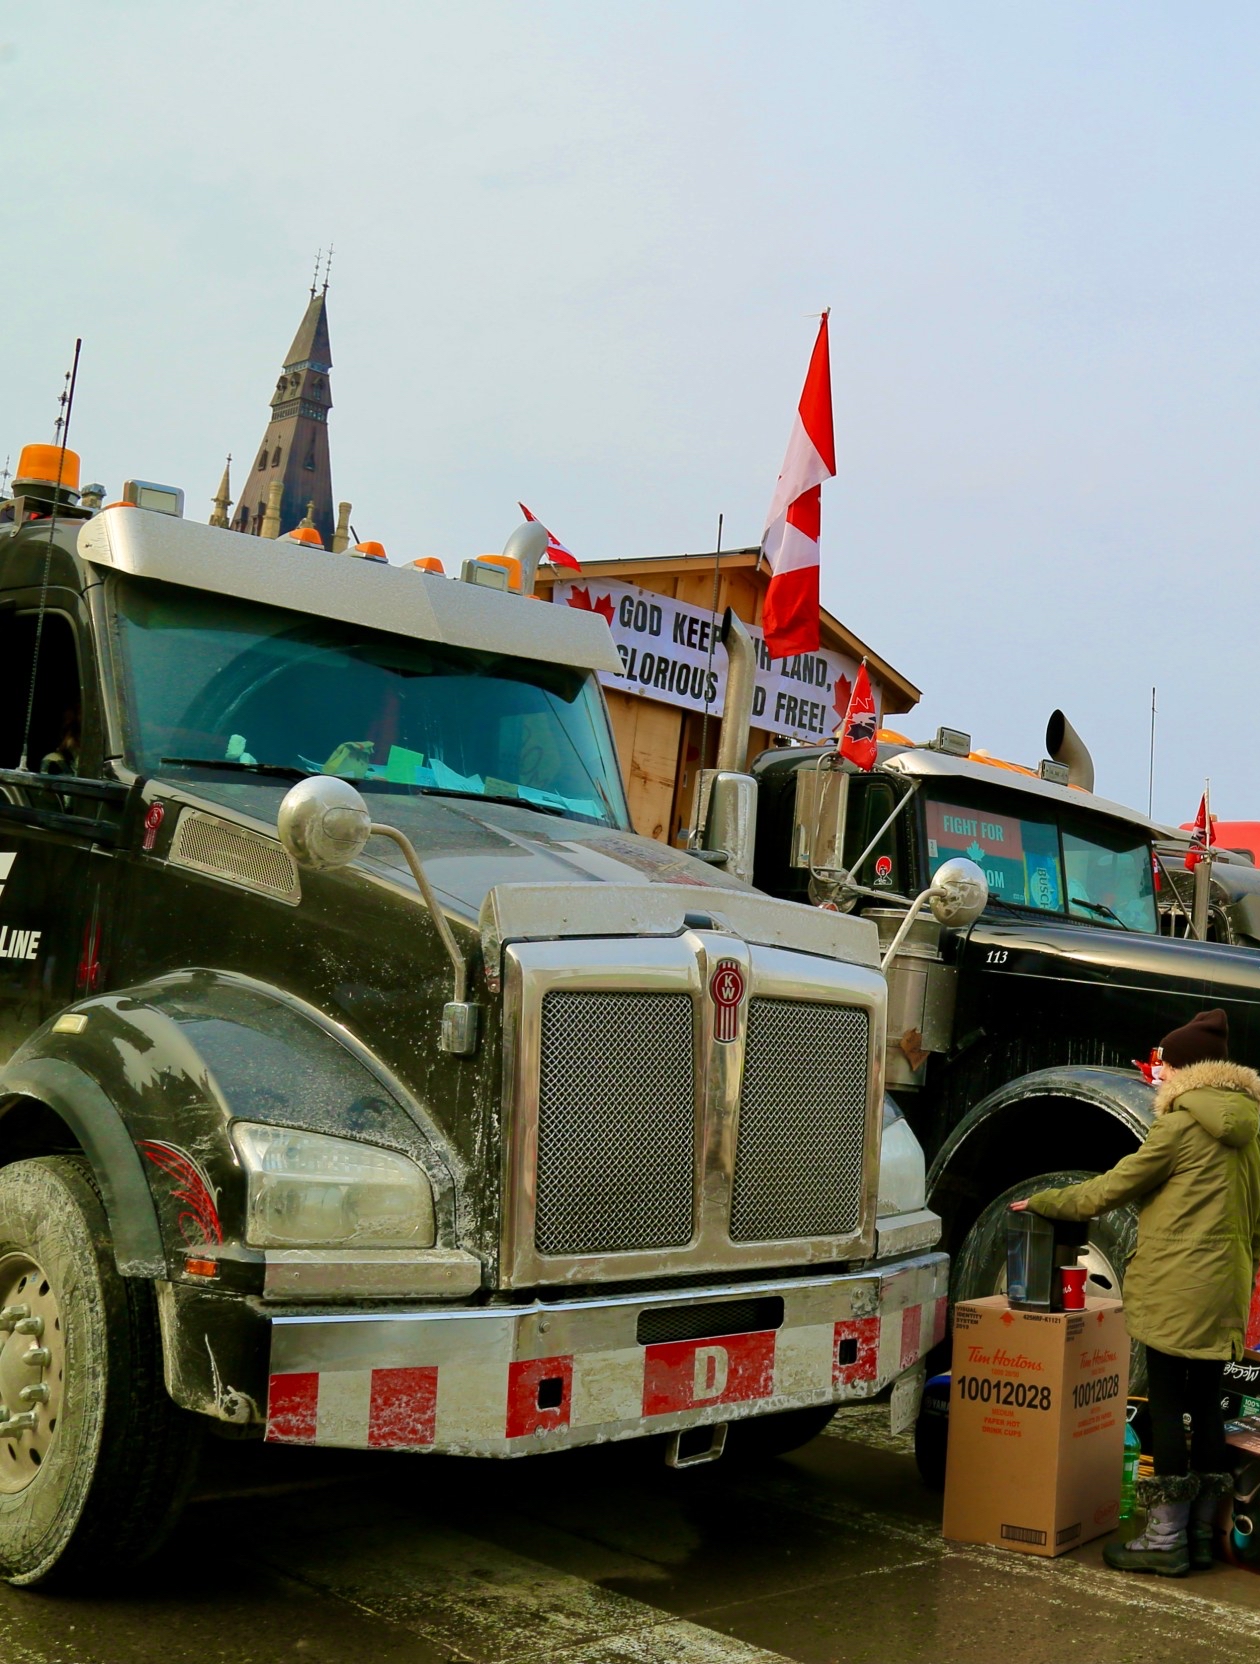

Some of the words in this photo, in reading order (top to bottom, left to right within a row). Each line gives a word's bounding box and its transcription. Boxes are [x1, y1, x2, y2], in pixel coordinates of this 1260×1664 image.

[619, 594, 663, 637] GOD
[673, 611, 723, 655] KEEP
[780, 650, 832, 692] LAND,
[774, 691, 826, 735] FREE!
[943, 815, 978, 837] FIGHT
[981, 822, 1005, 842] FOR
[1036, 867, 1048, 910] BUSCH
[986, 950, 1009, 964] 113
[724, 975, 733, 988] K
[721, 987, 736, 1000] W
[956, 1311, 983, 1320] IDENTITY
[956, 1317, 978, 1325] SYSTEM
[967, 1346, 990, 1364] Tim
[992, 1348, 1044, 1372] Hortons
[1080, 1352, 1092, 1369] Tim
[1092, 1348, 1118, 1368] Hortons
[693, 1345, 729, 1401] D
[957, 1375, 1052, 1411] 10012028
[1072, 1374, 1120, 1410] 10012028
[982, 1426, 1002, 1435] DRINK
[1004, 1428, 1022, 1438] CUPS
[984, 1417, 1004, 1426] PAPER
[1006, 1420, 1021, 1428] HOT
